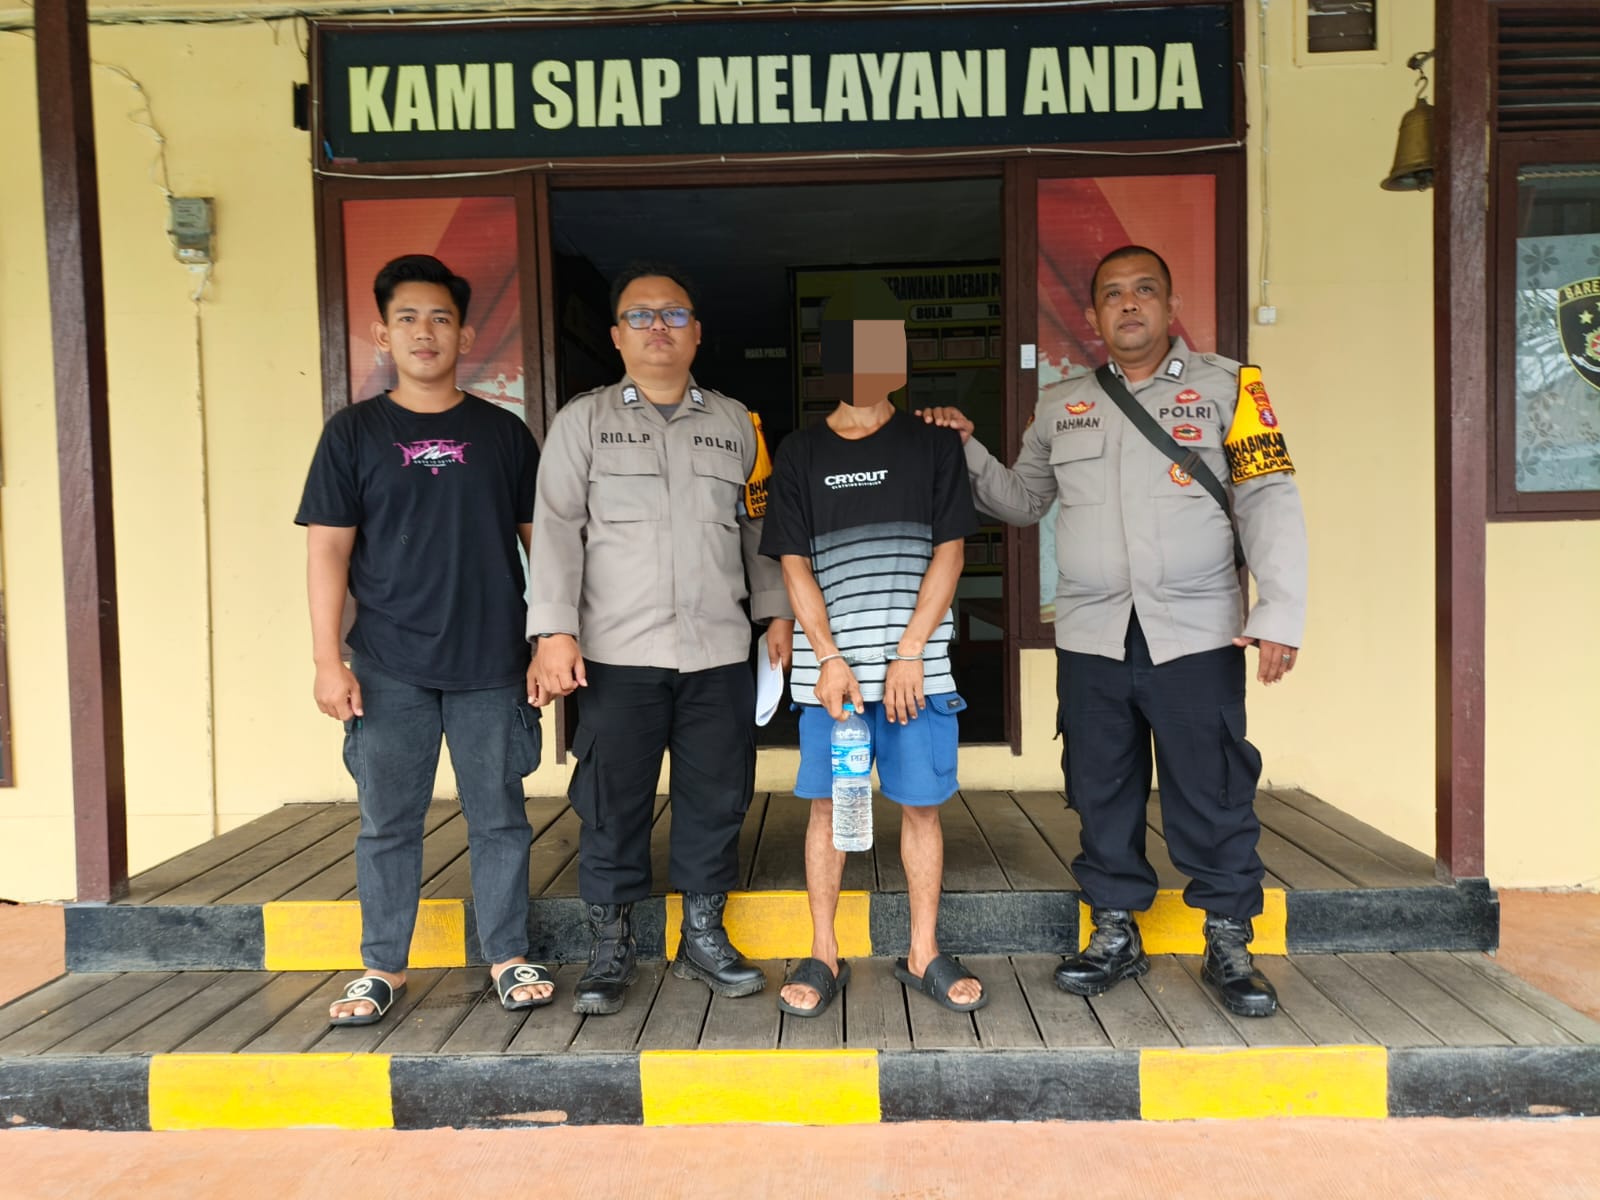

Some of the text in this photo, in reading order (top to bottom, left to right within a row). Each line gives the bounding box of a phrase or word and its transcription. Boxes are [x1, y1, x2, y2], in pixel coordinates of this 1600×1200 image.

[348, 42, 1204, 135] KAMI SIAP MELAYANI ANDA
[949, 272, 990, 297] DAERAH
[1564, 281, 1600, 299] BARE
[916, 303, 1001, 320] BULAN TA
[1158, 406, 1211, 419] POLRI
[1056, 417, 1100, 432] RAHMAN
[693, 435, 738, 453] POLRI
[824, 470, 888, 485] CRYOUT
